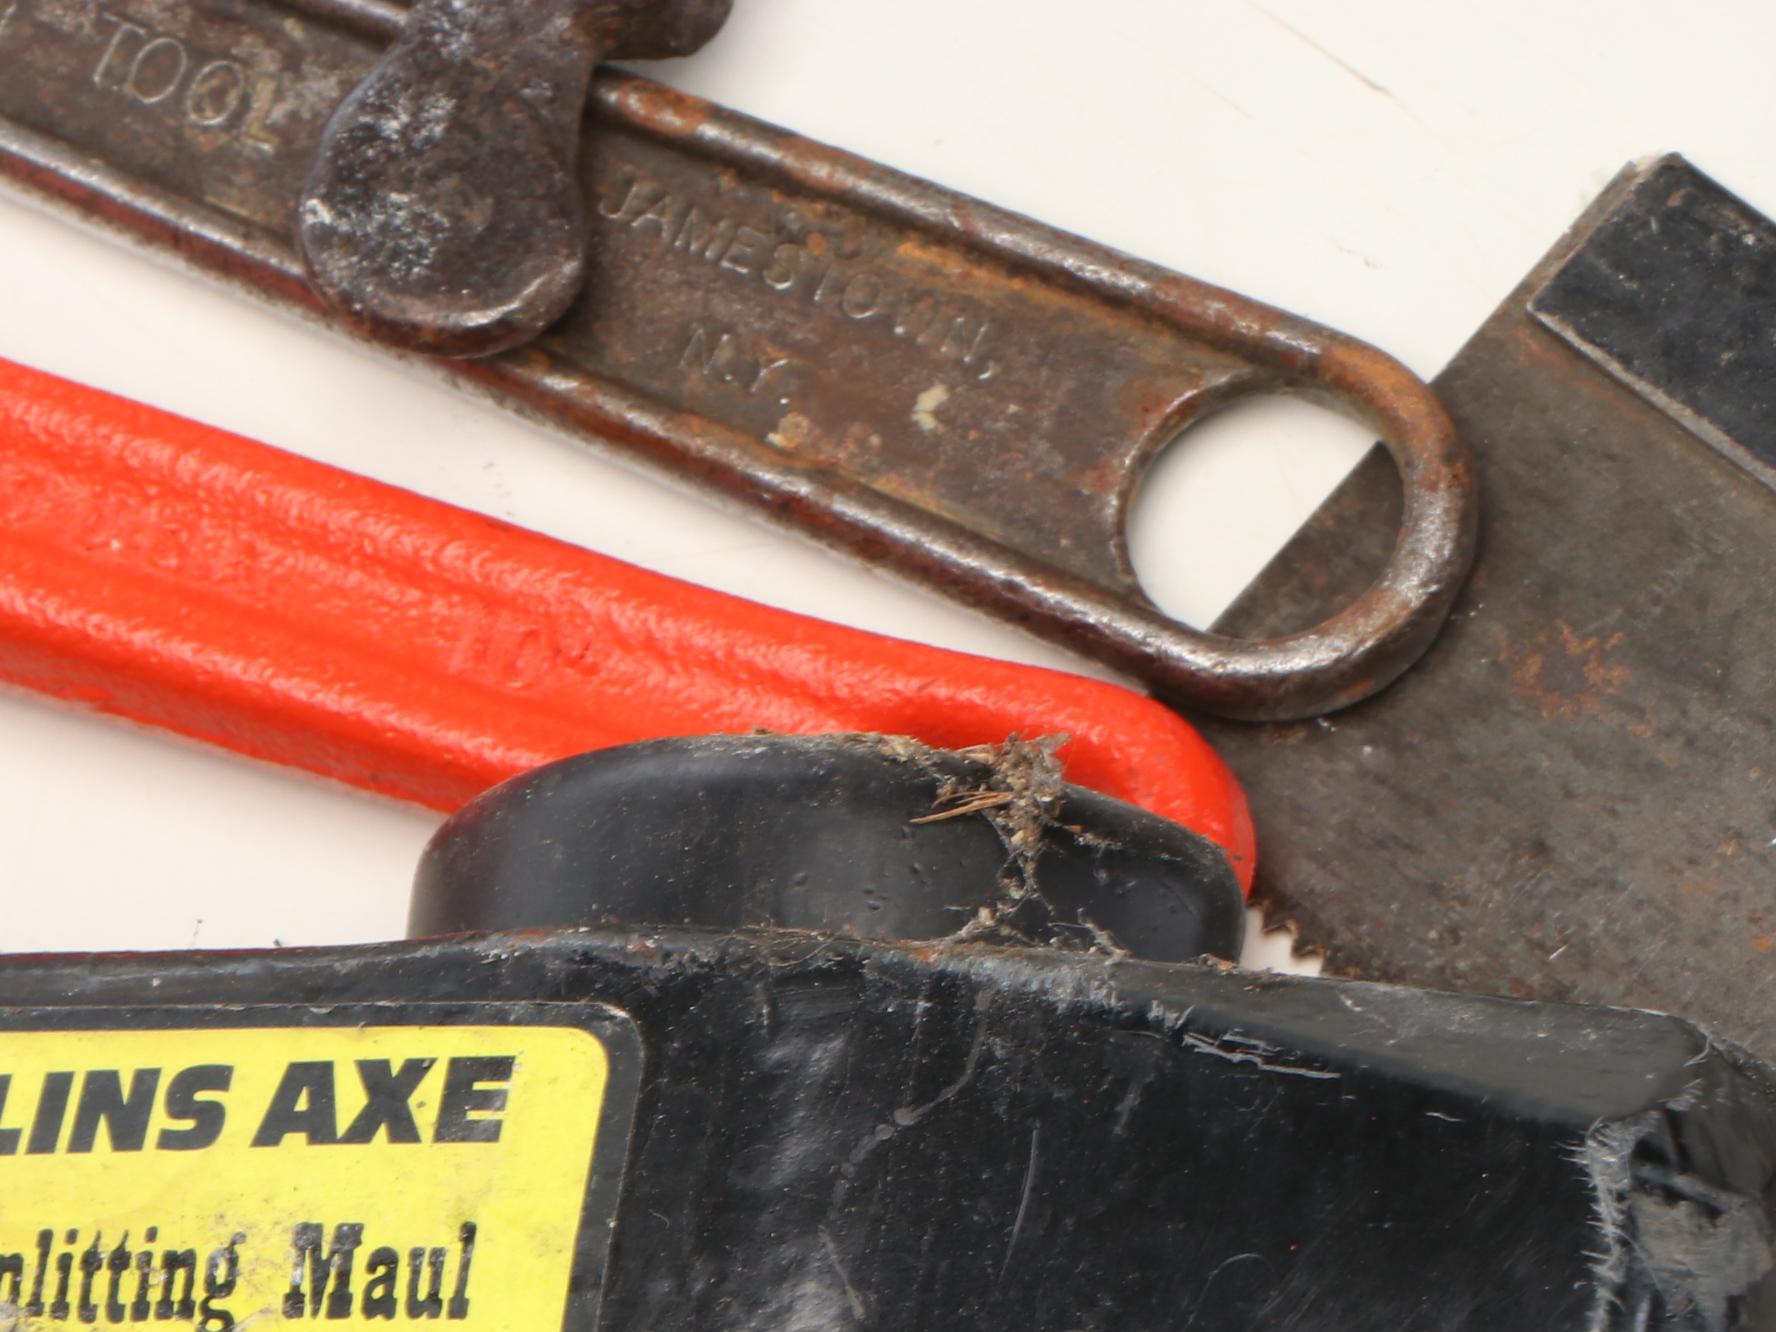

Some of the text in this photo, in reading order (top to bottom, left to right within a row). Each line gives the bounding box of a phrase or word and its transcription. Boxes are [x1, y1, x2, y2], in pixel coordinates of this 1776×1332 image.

[93, 12, 279, 154] TOOL
[252, 1055, 515, 1147] AXE
[281, 1221, 477, 1320] Maul
